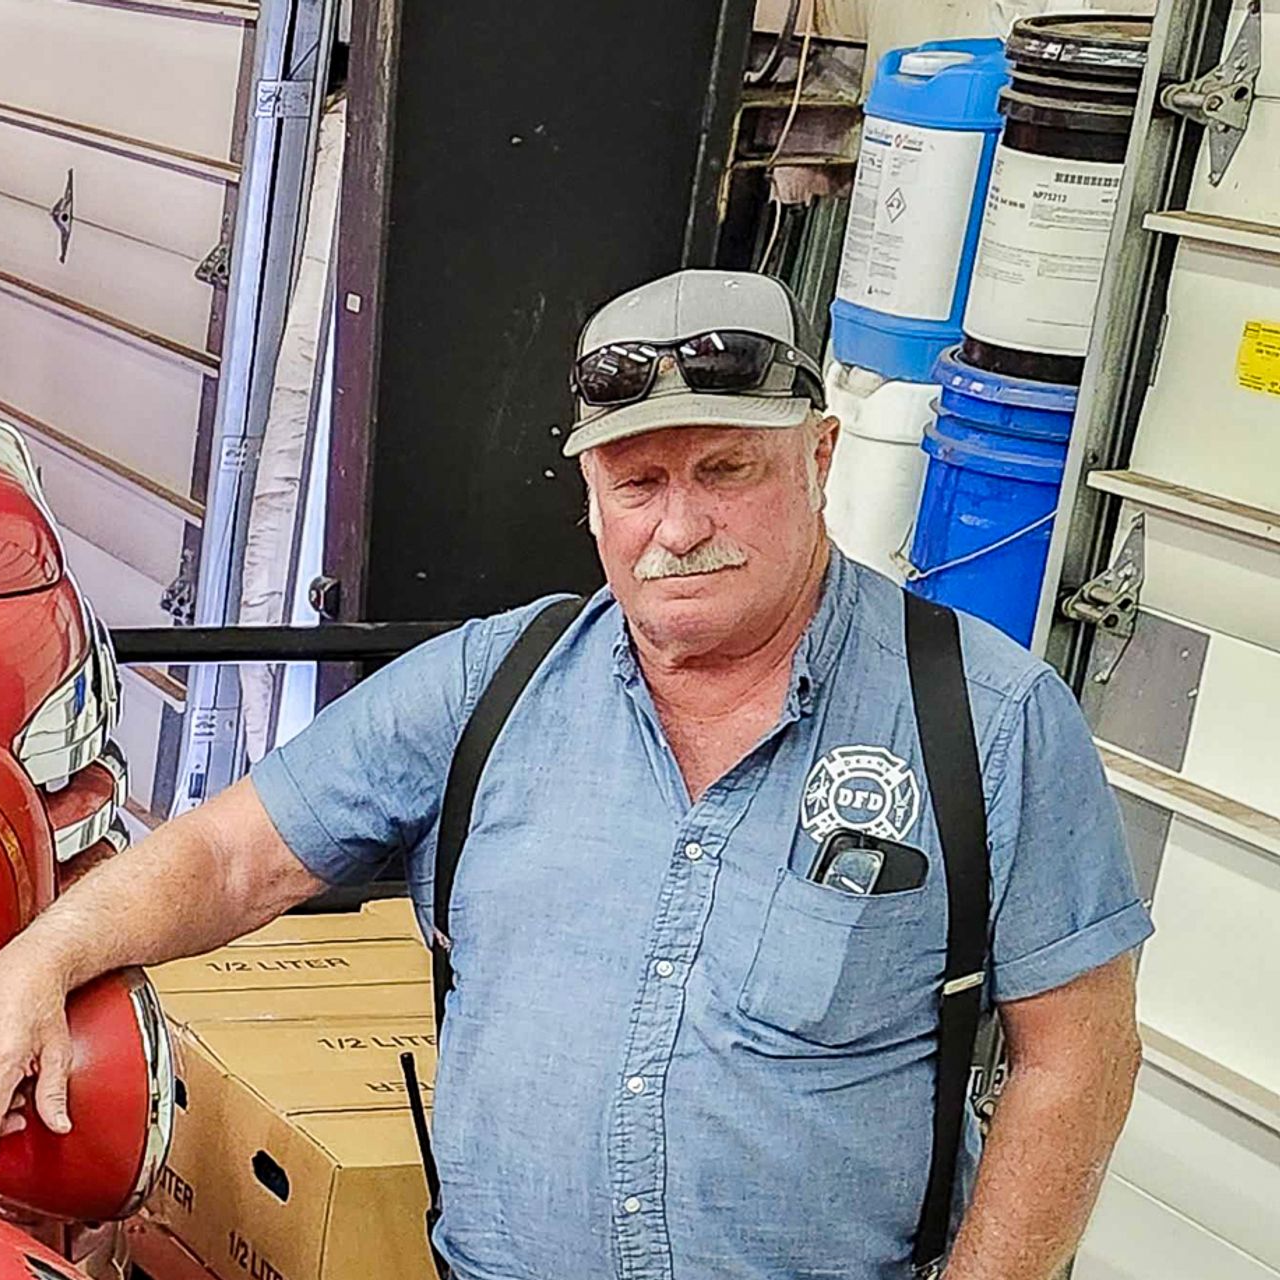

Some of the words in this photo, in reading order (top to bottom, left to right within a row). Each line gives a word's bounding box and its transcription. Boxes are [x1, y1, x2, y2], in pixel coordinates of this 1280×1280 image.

[837, 787, 883, 812] DFD
[206, 960, 251, 972] 1/2
[257, 957, 350, 972] LITER
[318, 1038, 367, 1050] 1/2
[371, 1033, 436, 1048] LITE
[366, 1081, 436, 1093] TER
[159, 1166, 194, 1213] ITER
[229, 1230, 249, 1269] 1/2
